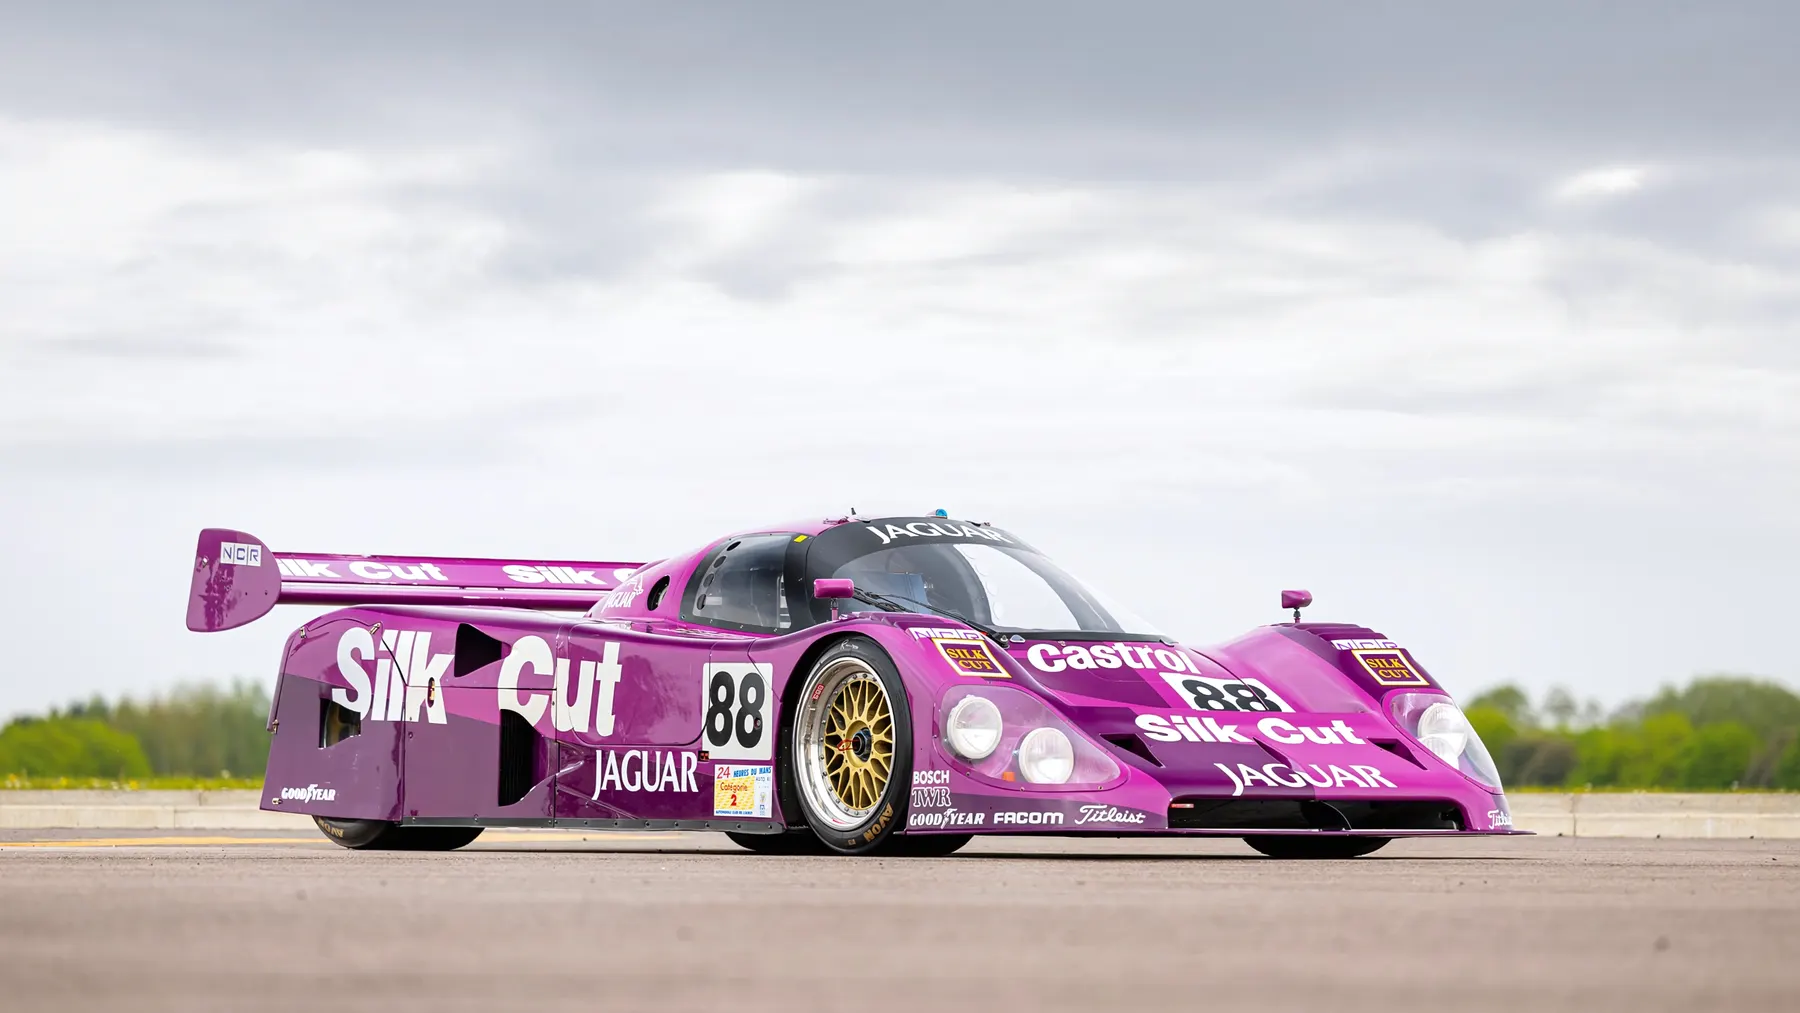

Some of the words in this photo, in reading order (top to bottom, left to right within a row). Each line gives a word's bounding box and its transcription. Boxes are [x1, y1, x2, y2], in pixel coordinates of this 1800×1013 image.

[866, 521, 1014, 545] JAGUAR
[223, 546, 259, 562] NCR
[273, 557, 342, 578] ilk
[349, 560, 449, 581] Cut
[502, 564, 608, 585] Silk
[601, 591, 636, 613] JAGUAR
[946, 648, 988, 660] SILK
[959, 660, 993, 670] CUT
[1027, 641, 1202, 674] Castrol
[1366, 658, 1406, 669] SILK
[331, 626, 456, 725] Silk
[1378, 669, 1412, 679] CUT
[497, 635, 623, 737] Cut
[1181, 679, 1282, 712] 88
[706, 671, 765, 748] 88
[1135, 714, 1254, 743] Silk
[1257, 717, 1366, 745] Cut
[592, 749, 699, 800] JAGUAR
[717, 766, 731, 779] 24
[913, 770, 950, 784] BOSCH
[1213, 762, 1398, 797] JAGUAR
[281, 784, 336, 803] GOODYEAR
[730, 794, 737, 806] 2
[911, 787, 952, 807] TWR
[863, 802, 894, 842] AVON
[909, 808, 985, 829] GOODYEAR
[993, 812, 1064, 824] FACOM
[1074, 804, 1146, 825] Titleist
